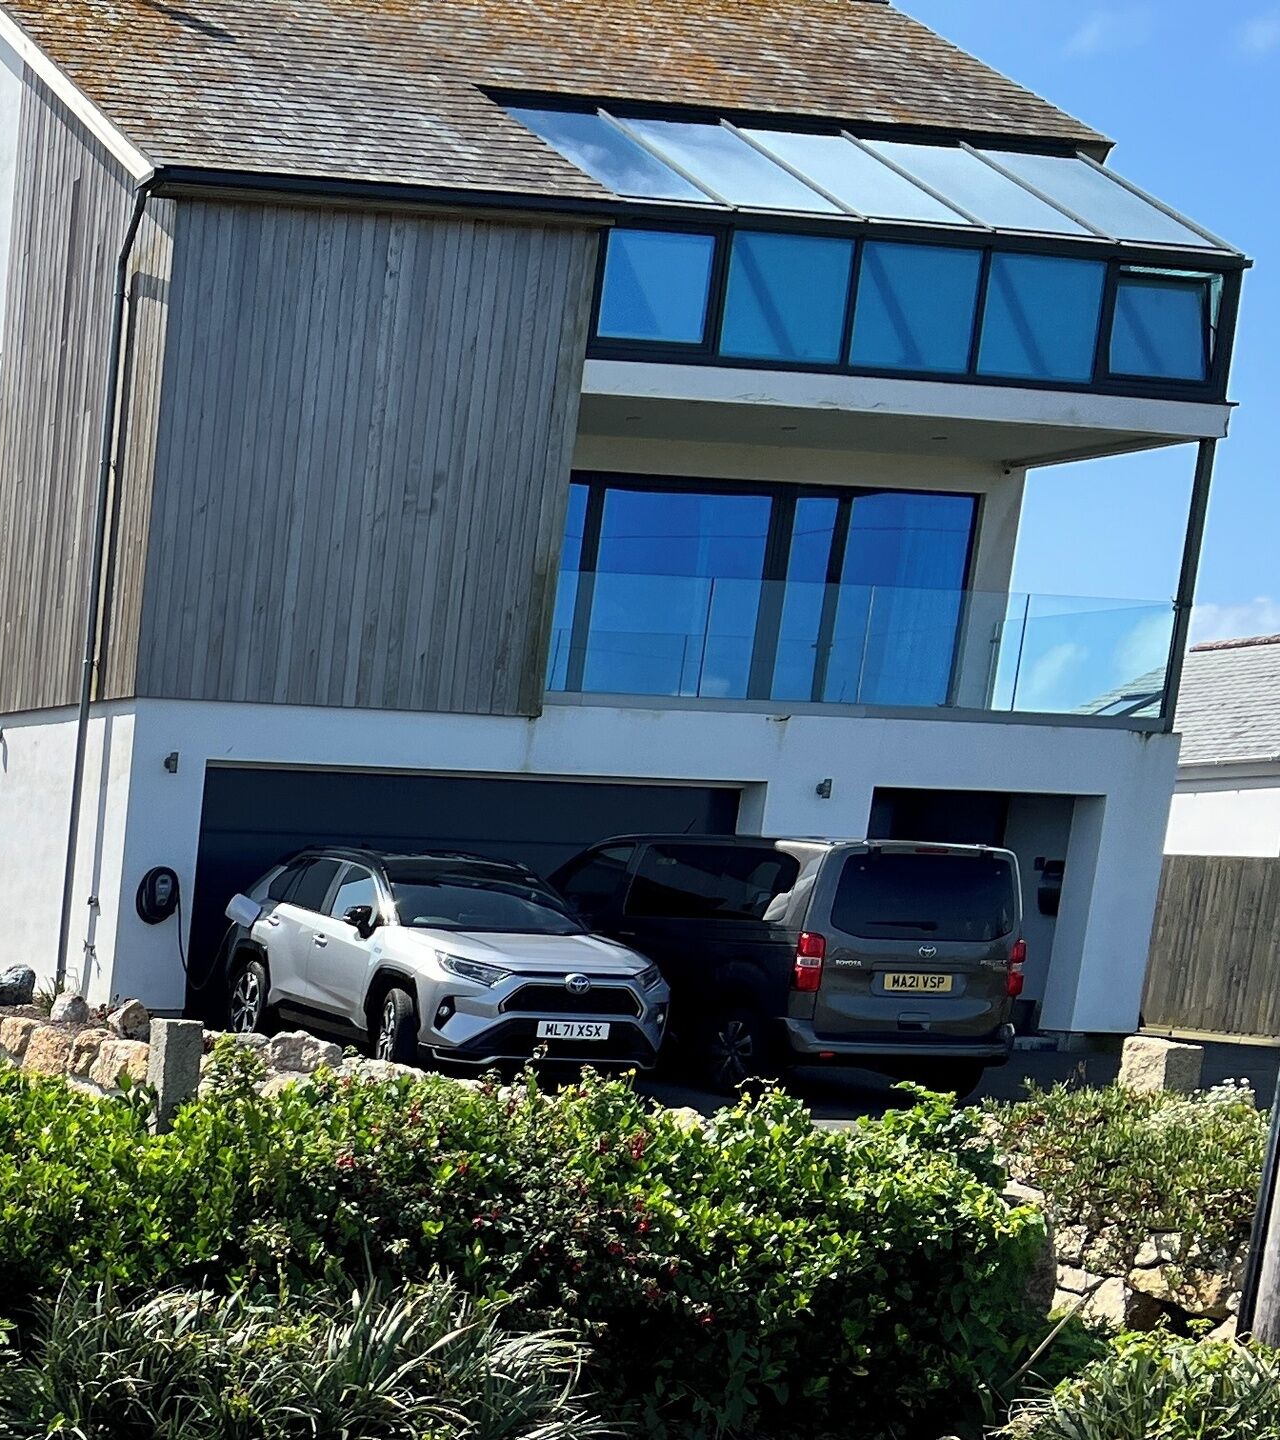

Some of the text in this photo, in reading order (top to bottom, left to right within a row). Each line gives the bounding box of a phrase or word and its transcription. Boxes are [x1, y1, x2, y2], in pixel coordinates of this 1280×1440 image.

[891, 975, 945, 989] MA21 VSP
[545, 1023, 603, 1038] ML71 XSX
